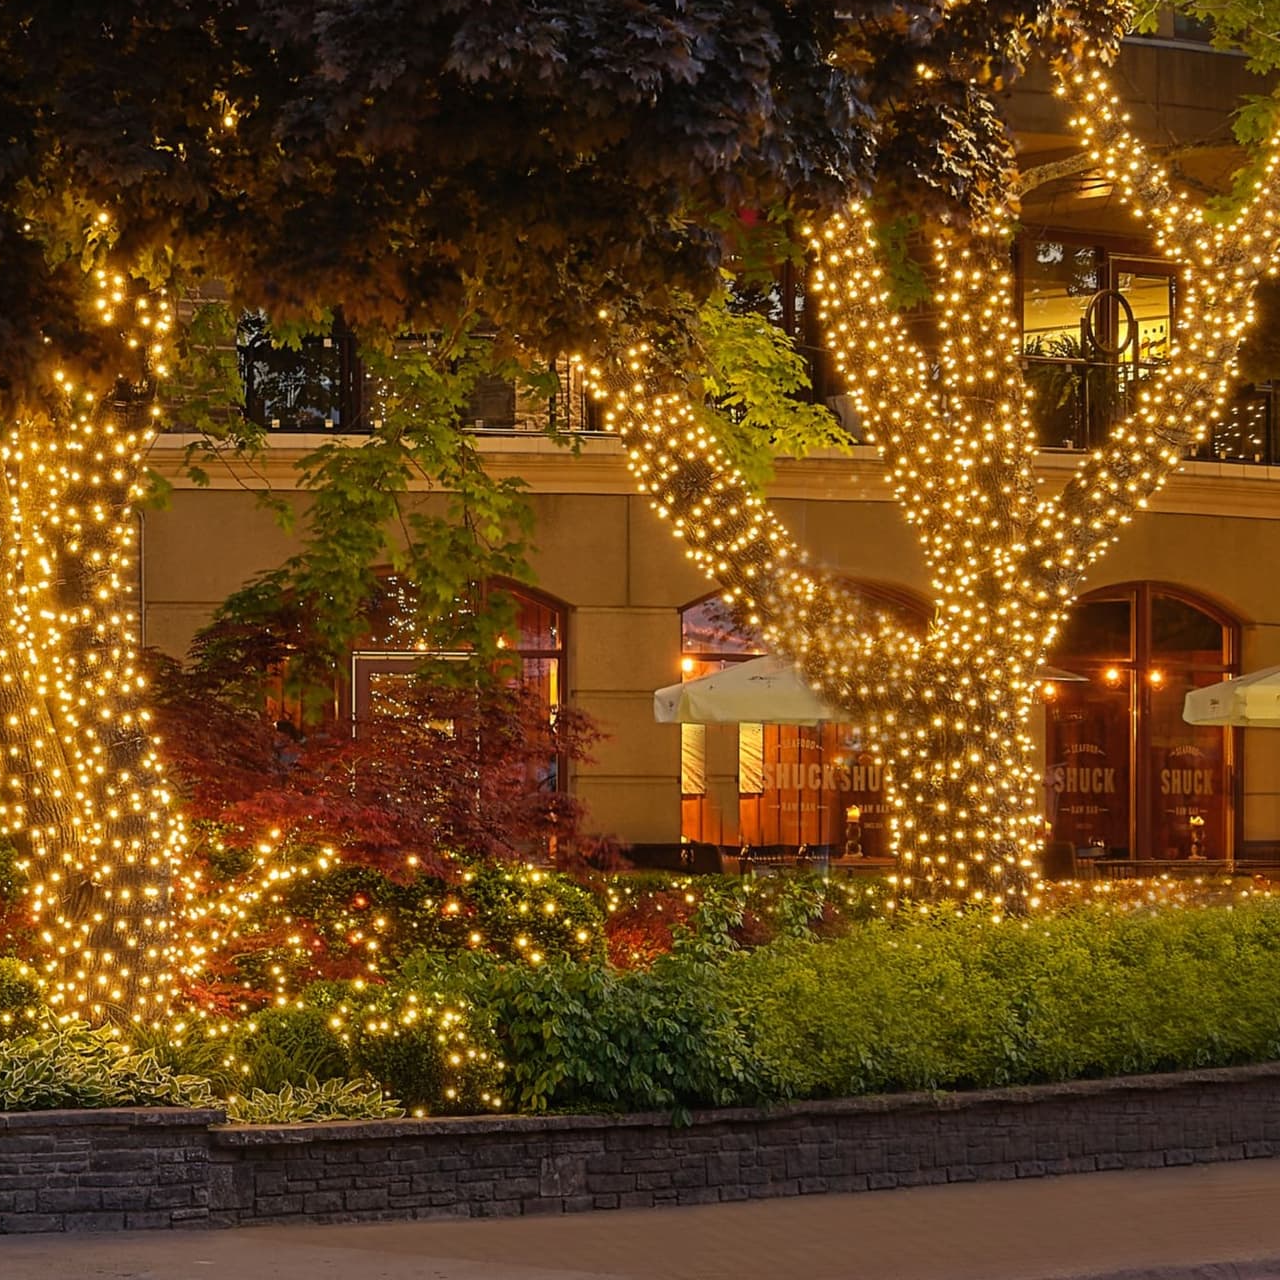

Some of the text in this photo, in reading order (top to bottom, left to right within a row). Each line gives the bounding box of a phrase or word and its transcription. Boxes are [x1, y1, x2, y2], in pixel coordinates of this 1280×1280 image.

[763, 762, 837, 790] SHUCK
[1054, 768, 1115, 793] SHUCK
[1161, 769, 1213, 795] SHUCK
